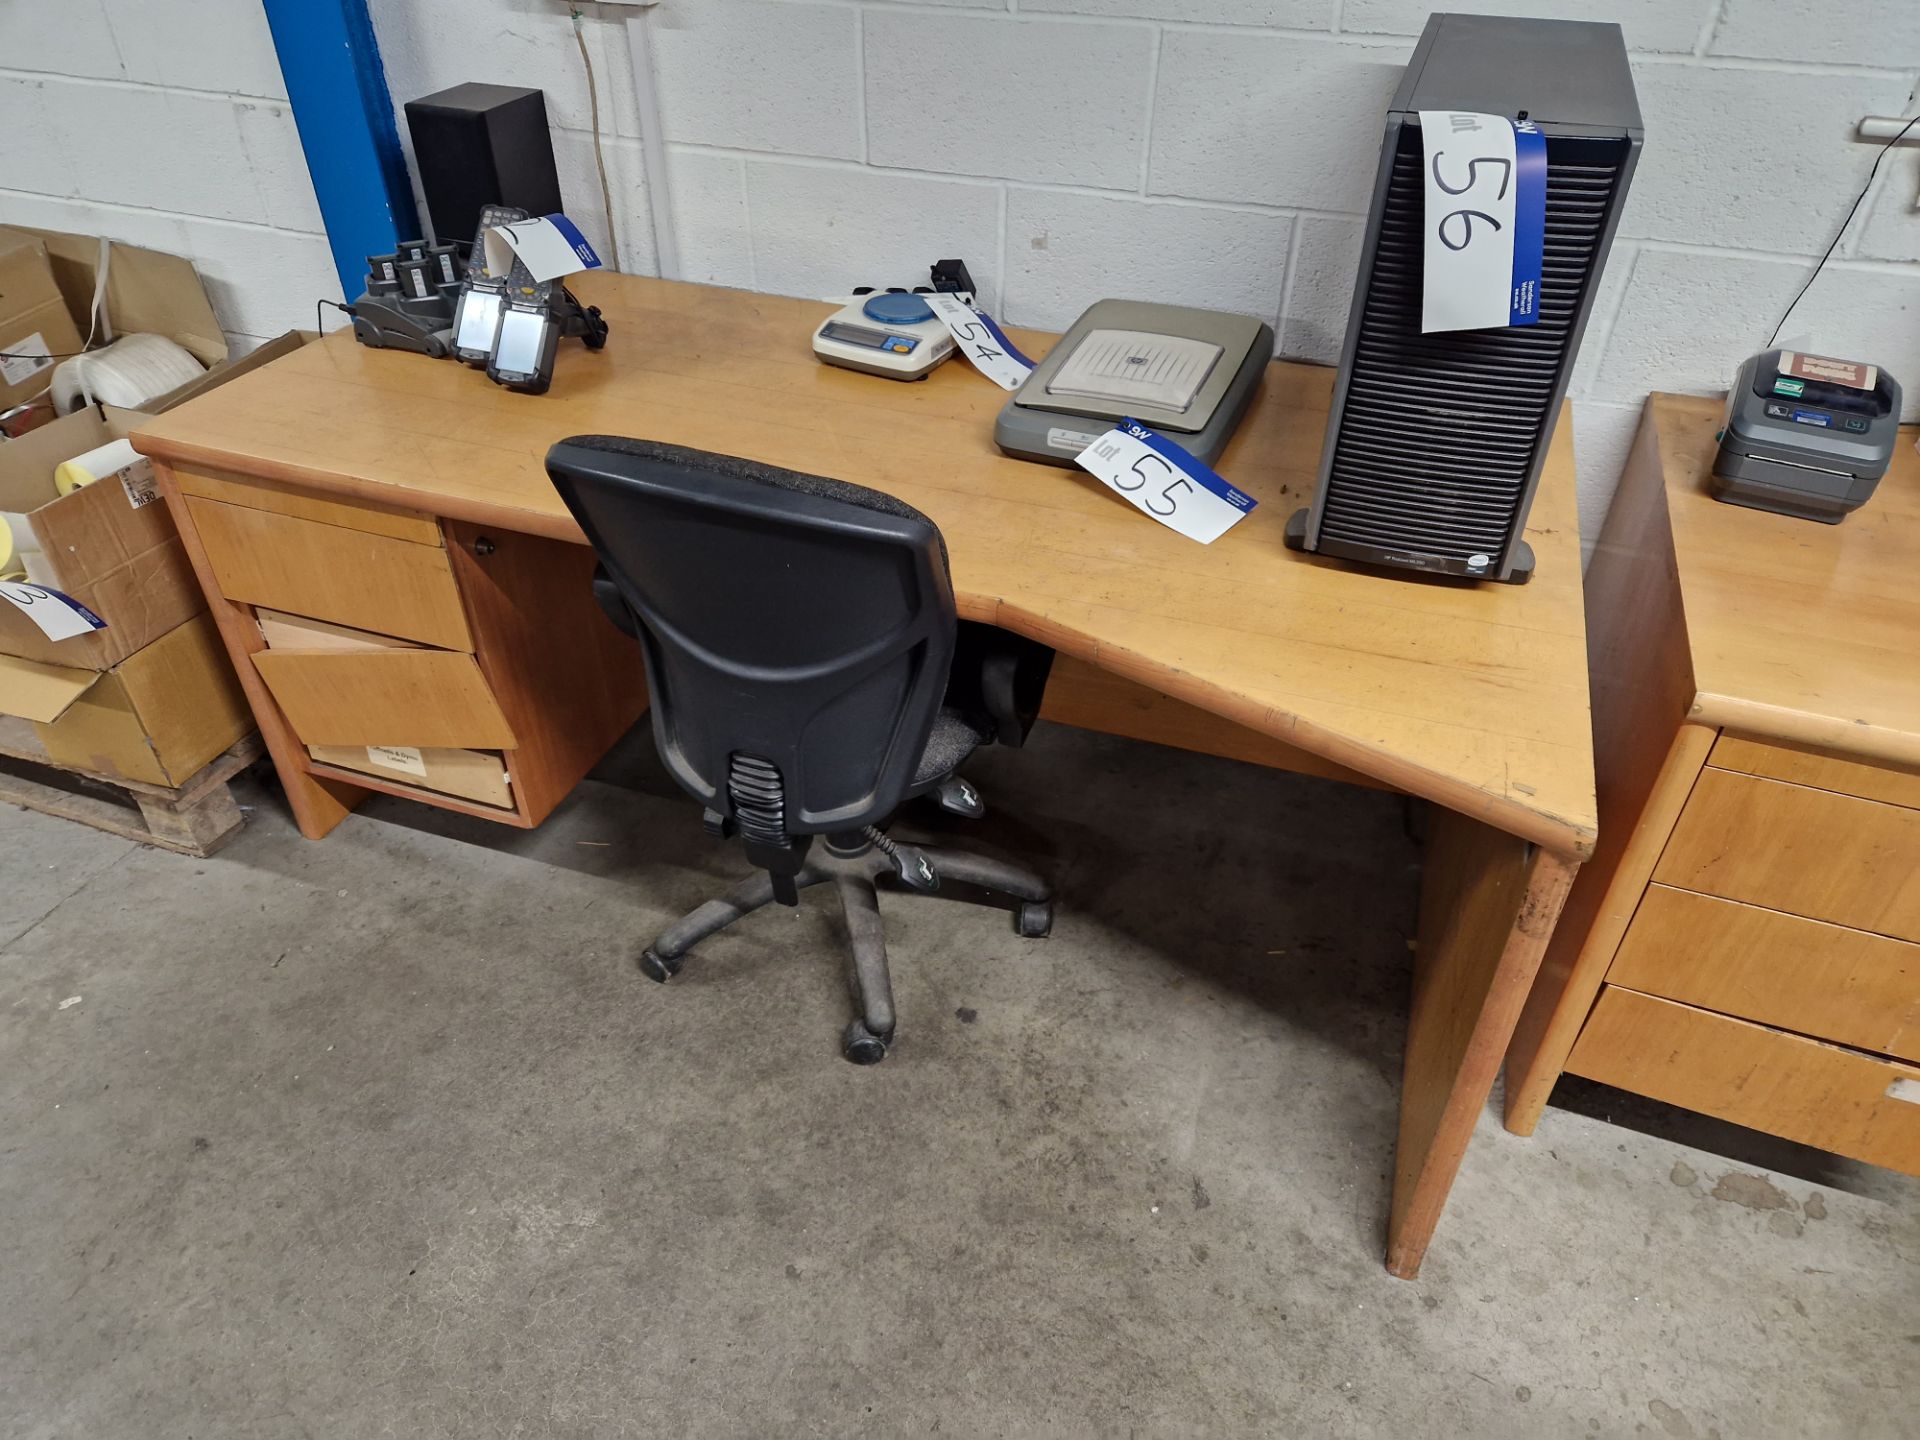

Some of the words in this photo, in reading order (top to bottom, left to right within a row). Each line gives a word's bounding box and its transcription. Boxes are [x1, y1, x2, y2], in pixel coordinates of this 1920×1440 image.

[1449, 114, 1482, 134] Lot
[1432, 151, 1511, 251] 56
[938, 300, 959, 313] Lot
[1526, 280, 1535, 314] Sanderson
[951, 322, 1003, 361] 54
[1093, 440, 1121, 462] Lot
[1114, 454, 1193, 516] 55
